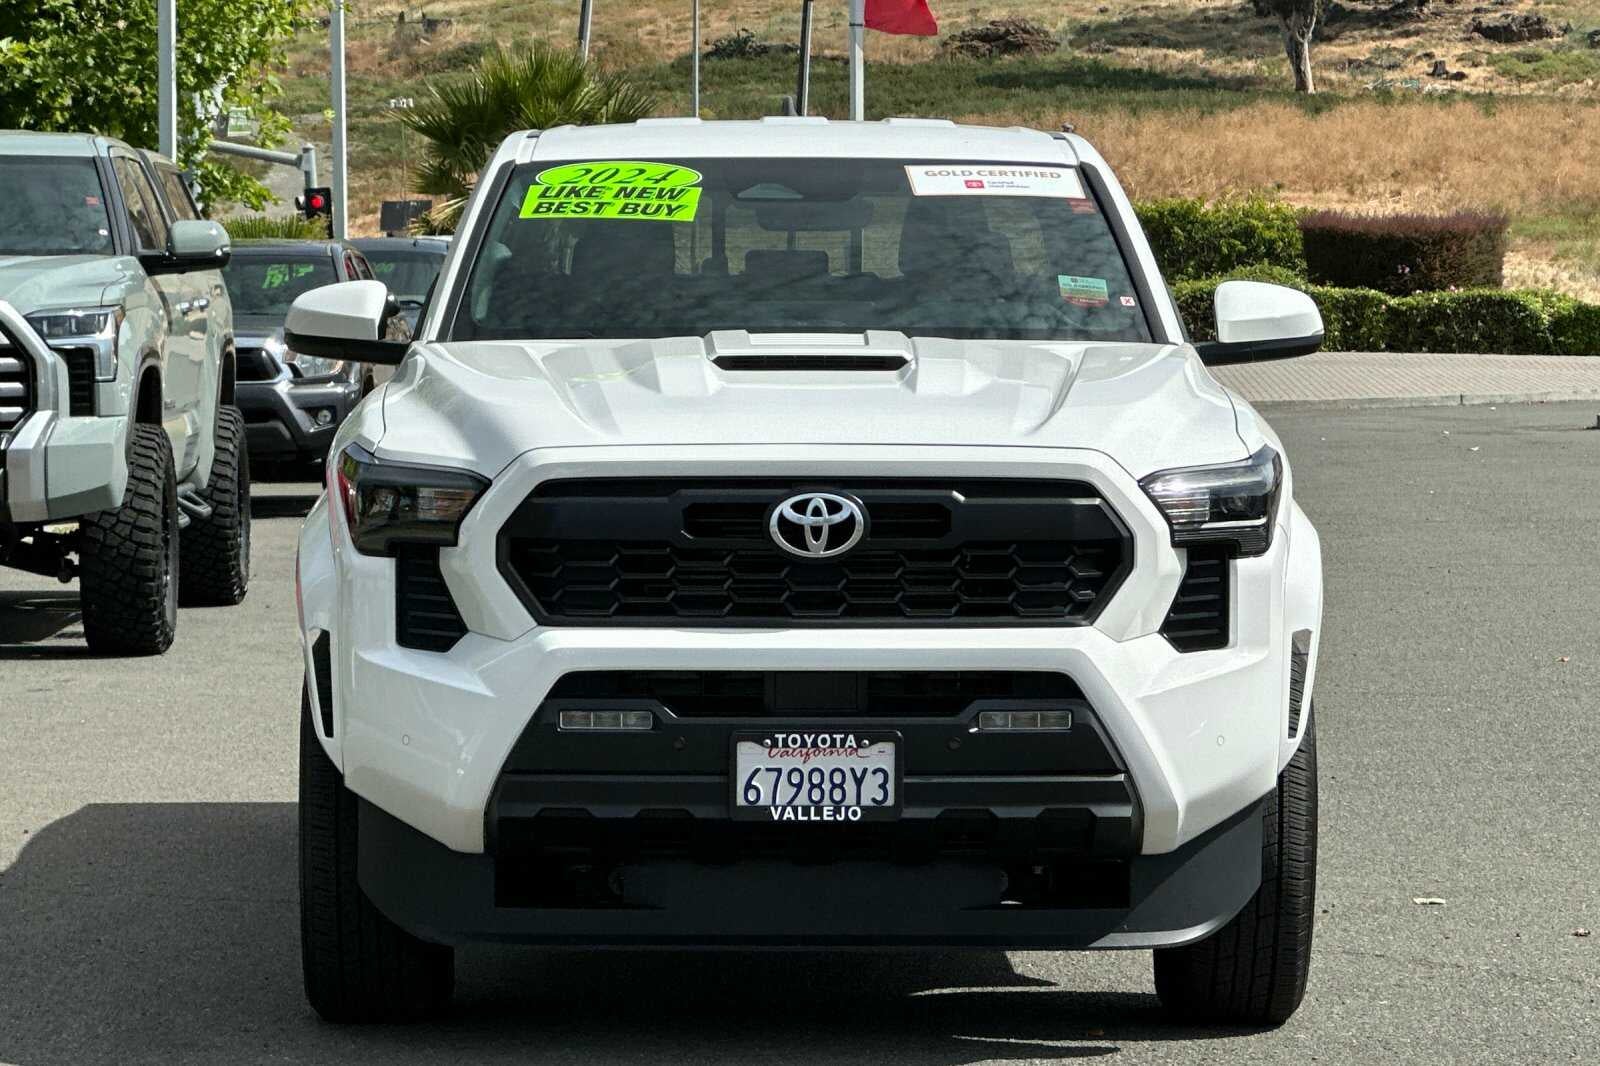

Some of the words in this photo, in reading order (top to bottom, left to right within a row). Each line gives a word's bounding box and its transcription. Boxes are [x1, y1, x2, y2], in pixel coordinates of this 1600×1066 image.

[560, 167, 680, 185] 2024
[924, 169, 973, 177] GOLD
[976, 169, 1062, 179] CERTIFIED
[537, 186, 609, 200] LIKE
[612, 186, 688, 201] NEW
[532, 202, 612, 216] BEST
[617, 203, 688, 218] BUY
[774, 733, 858, 749] TOYOTA
[743, 767, 889, 806] 67988Y3
[770, 806, 862, 821] VALLEJO
